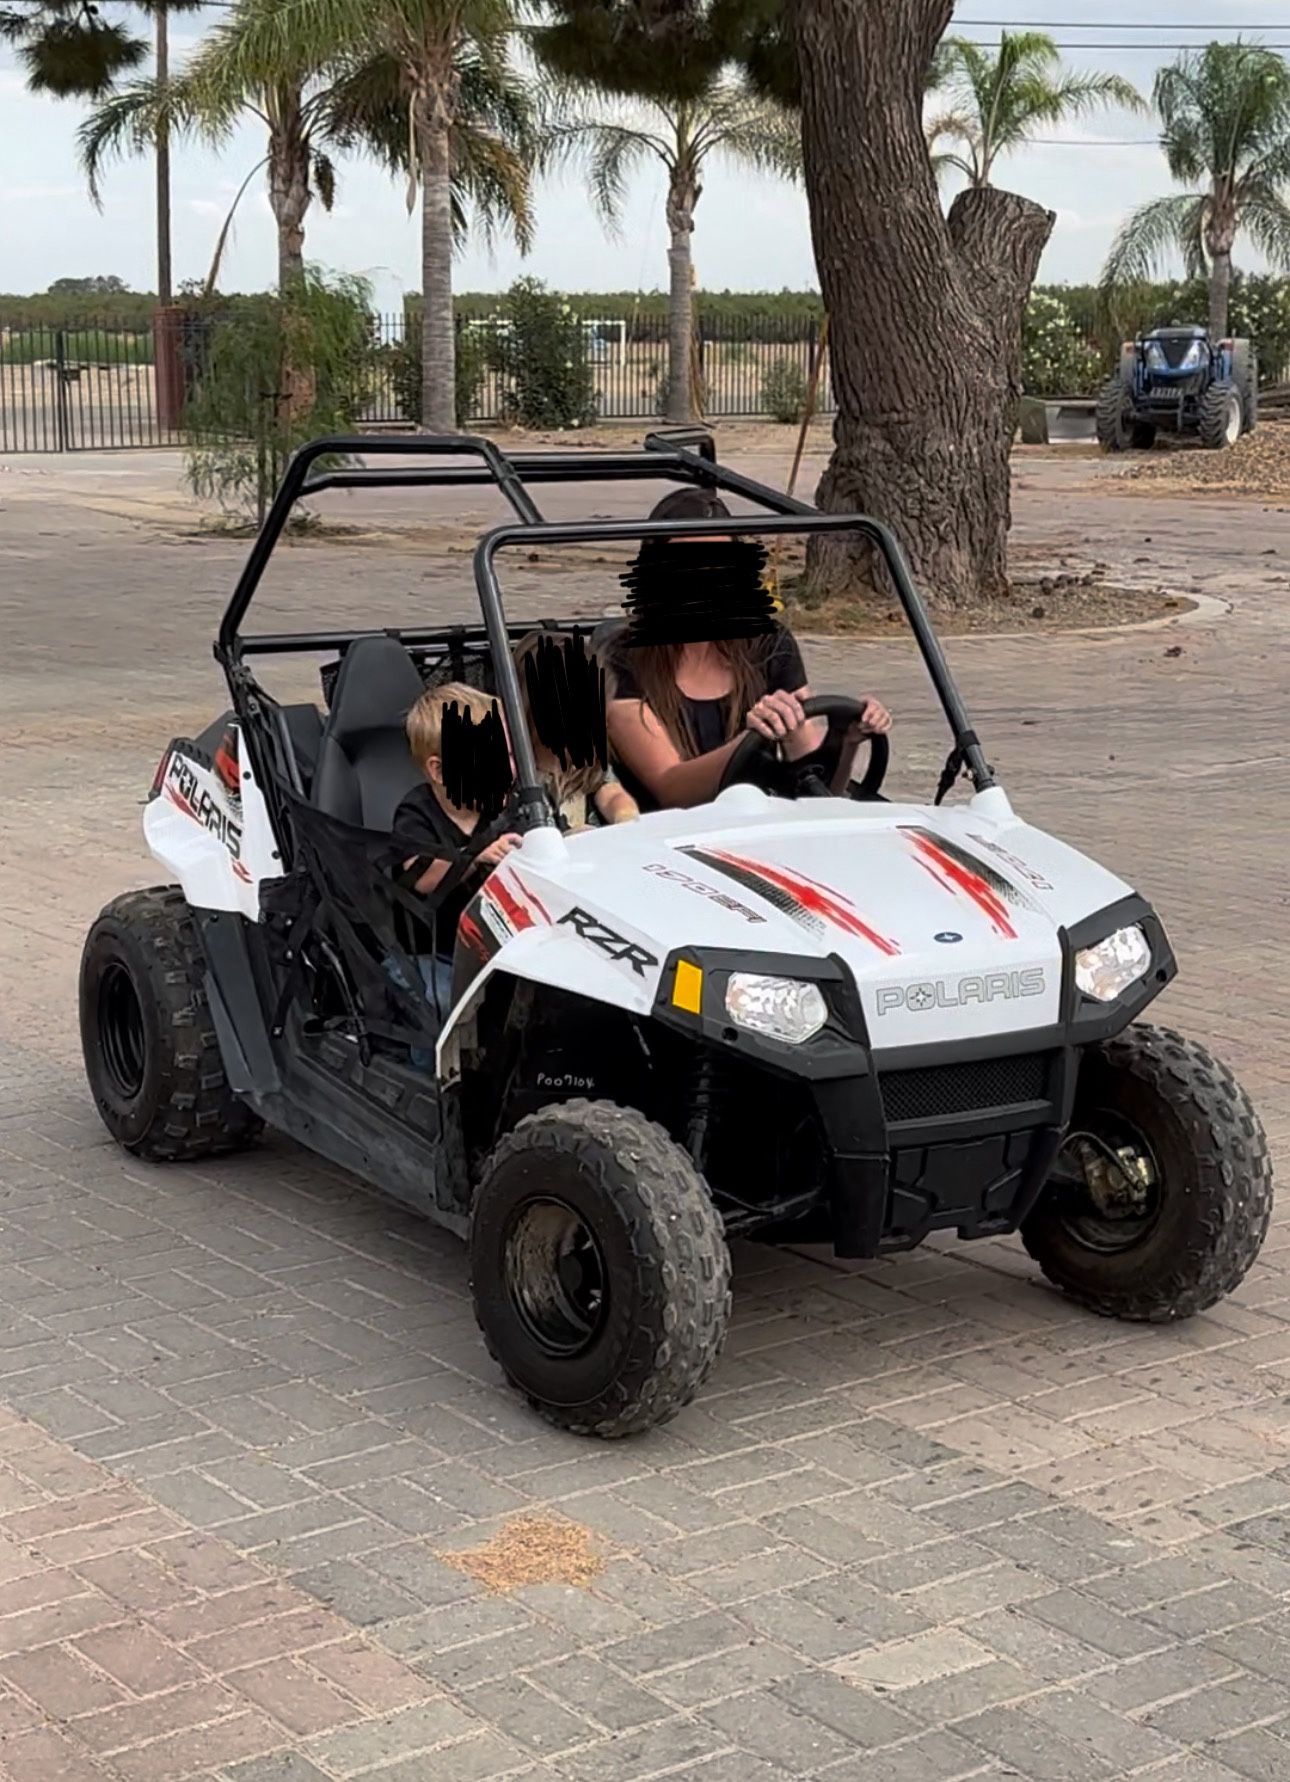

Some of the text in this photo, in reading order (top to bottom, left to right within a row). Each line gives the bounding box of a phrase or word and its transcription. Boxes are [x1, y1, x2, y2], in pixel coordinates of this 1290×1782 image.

[169, 753, 242, 860] POLARIS
[556, 906, 658, 977] RZR
[876, 967, 1046, 1016] POLARIS
